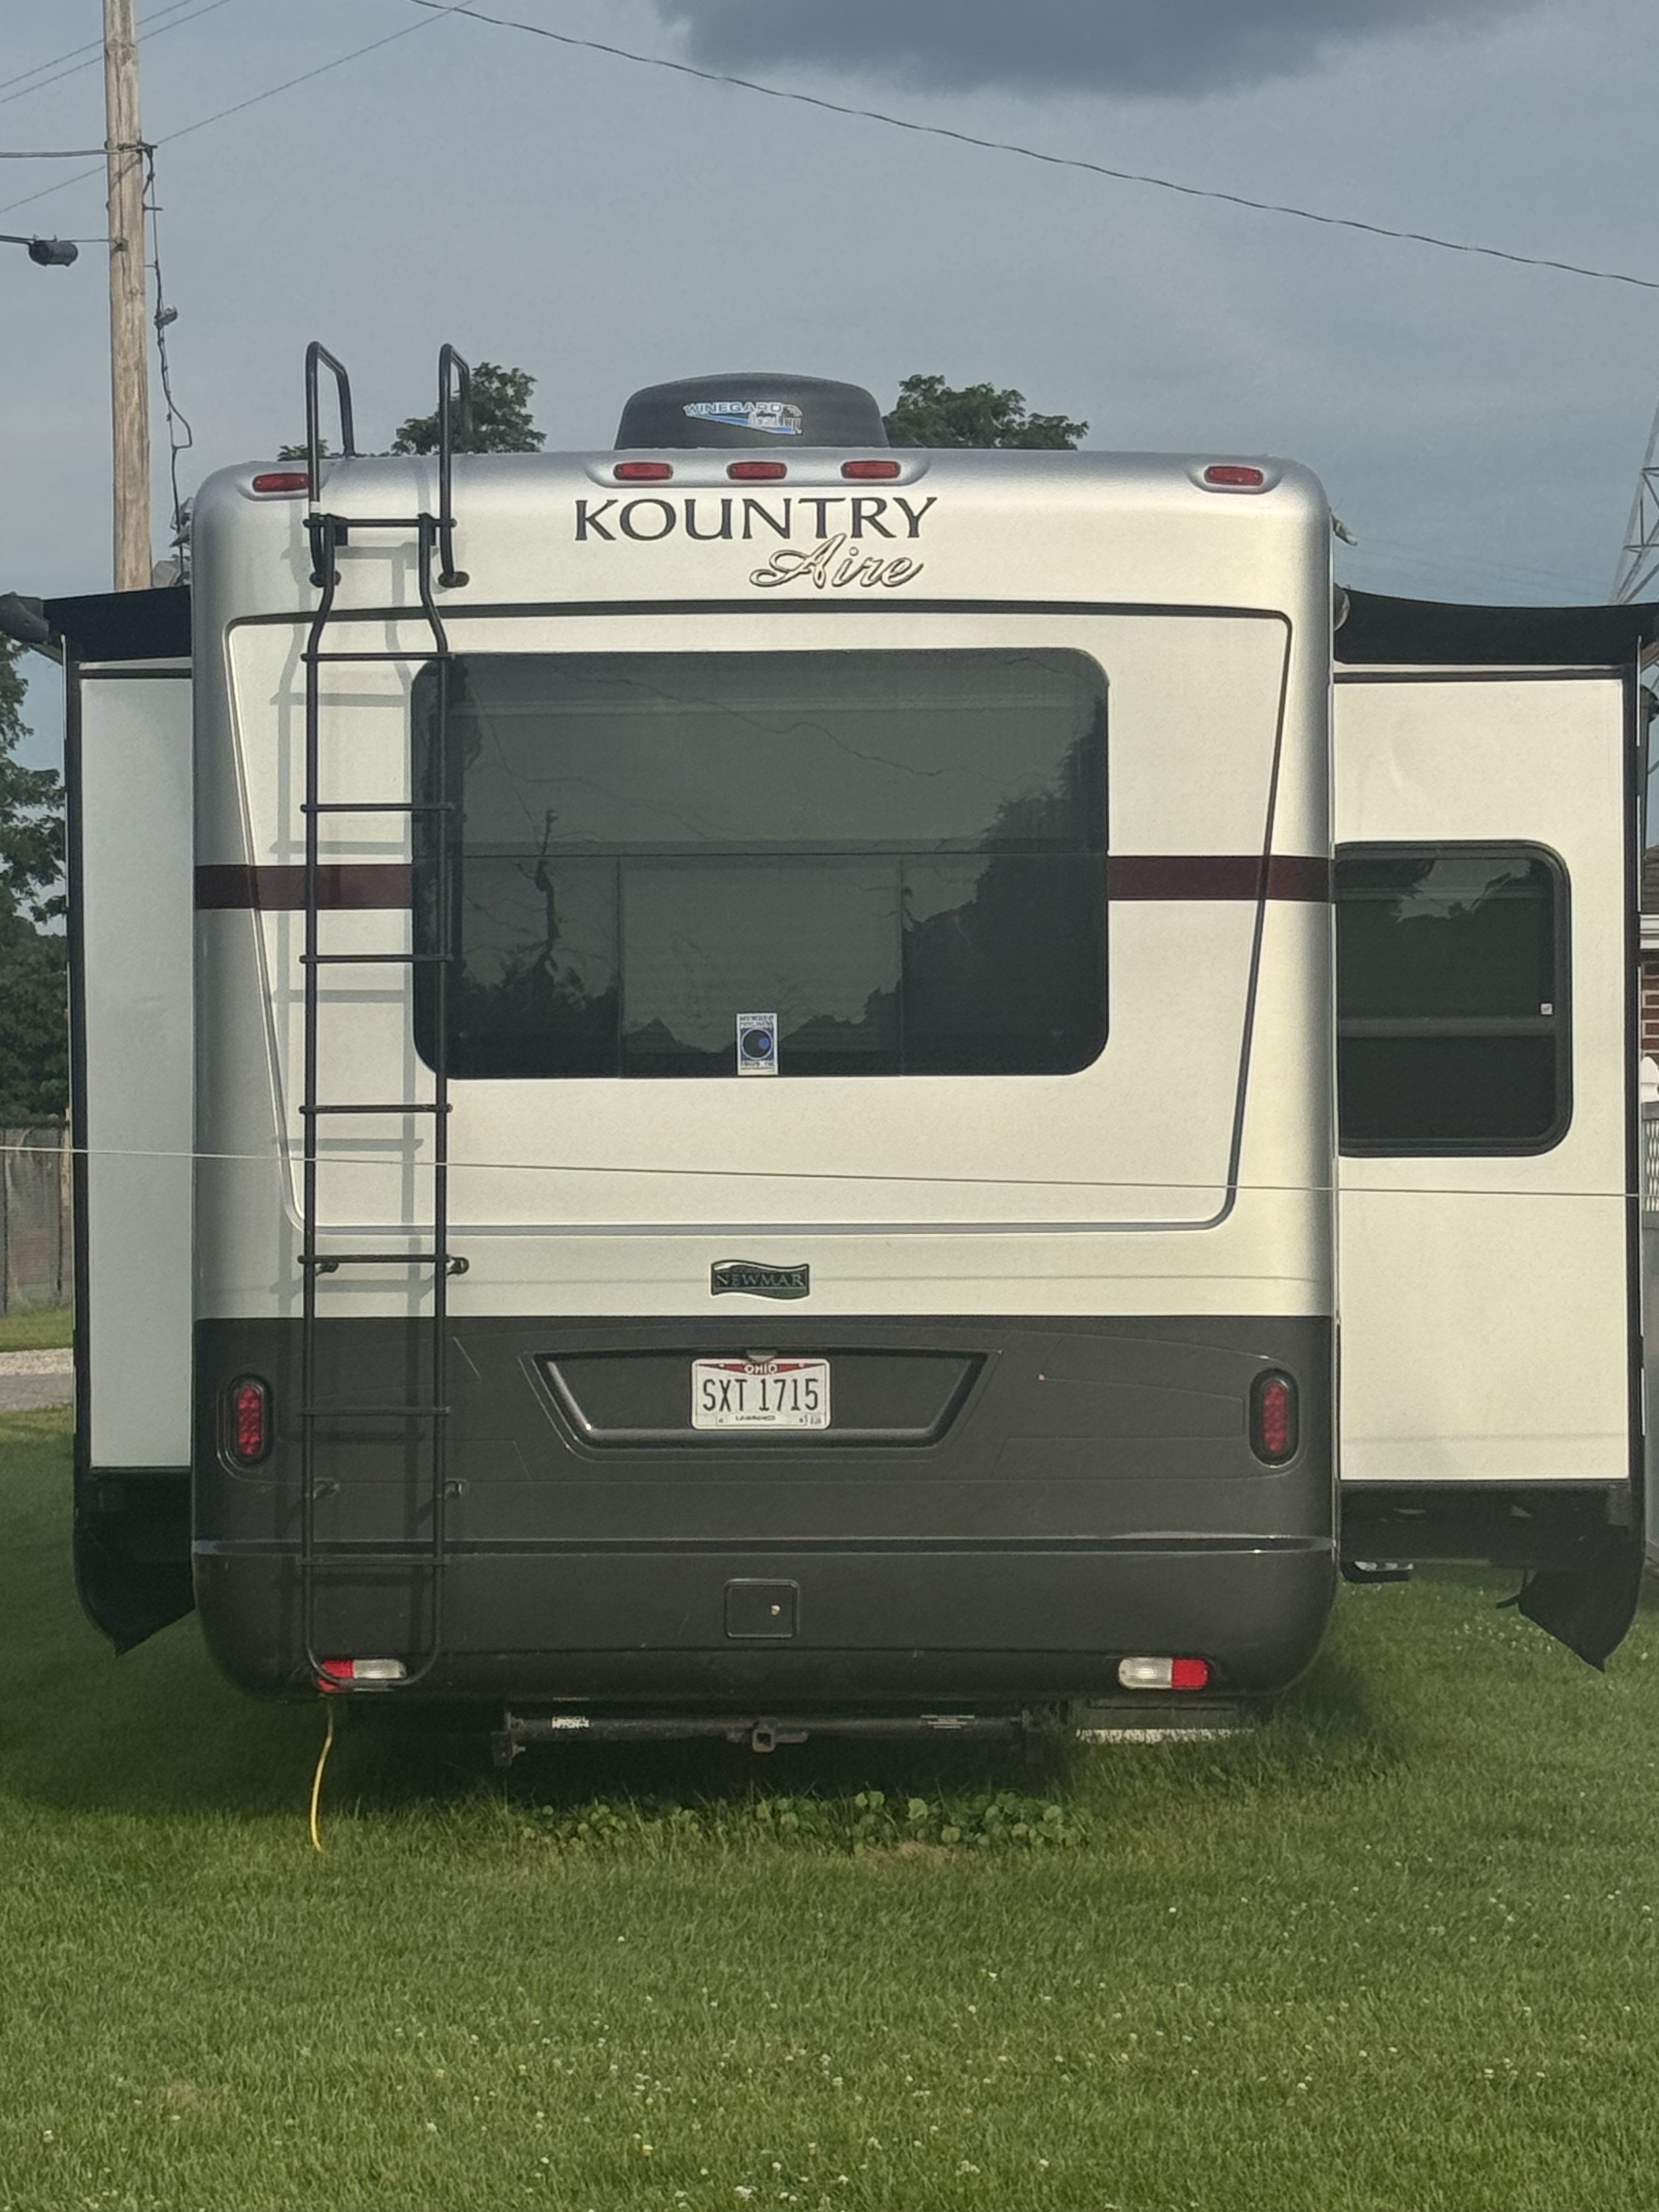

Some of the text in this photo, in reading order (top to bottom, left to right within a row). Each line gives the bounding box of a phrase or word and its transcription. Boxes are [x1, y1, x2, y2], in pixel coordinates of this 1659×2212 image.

[685, 401, 782, 416] WINEGARD
[574, 497, 938, 541] KOUNTRY
[749, 533, 924, 589] Aire
[716, 1274, 804, 1286] NEWMAR
[744, 1362, 778, 1374] OHIO
[702, 1378, 819, 1412] SXT 1715
